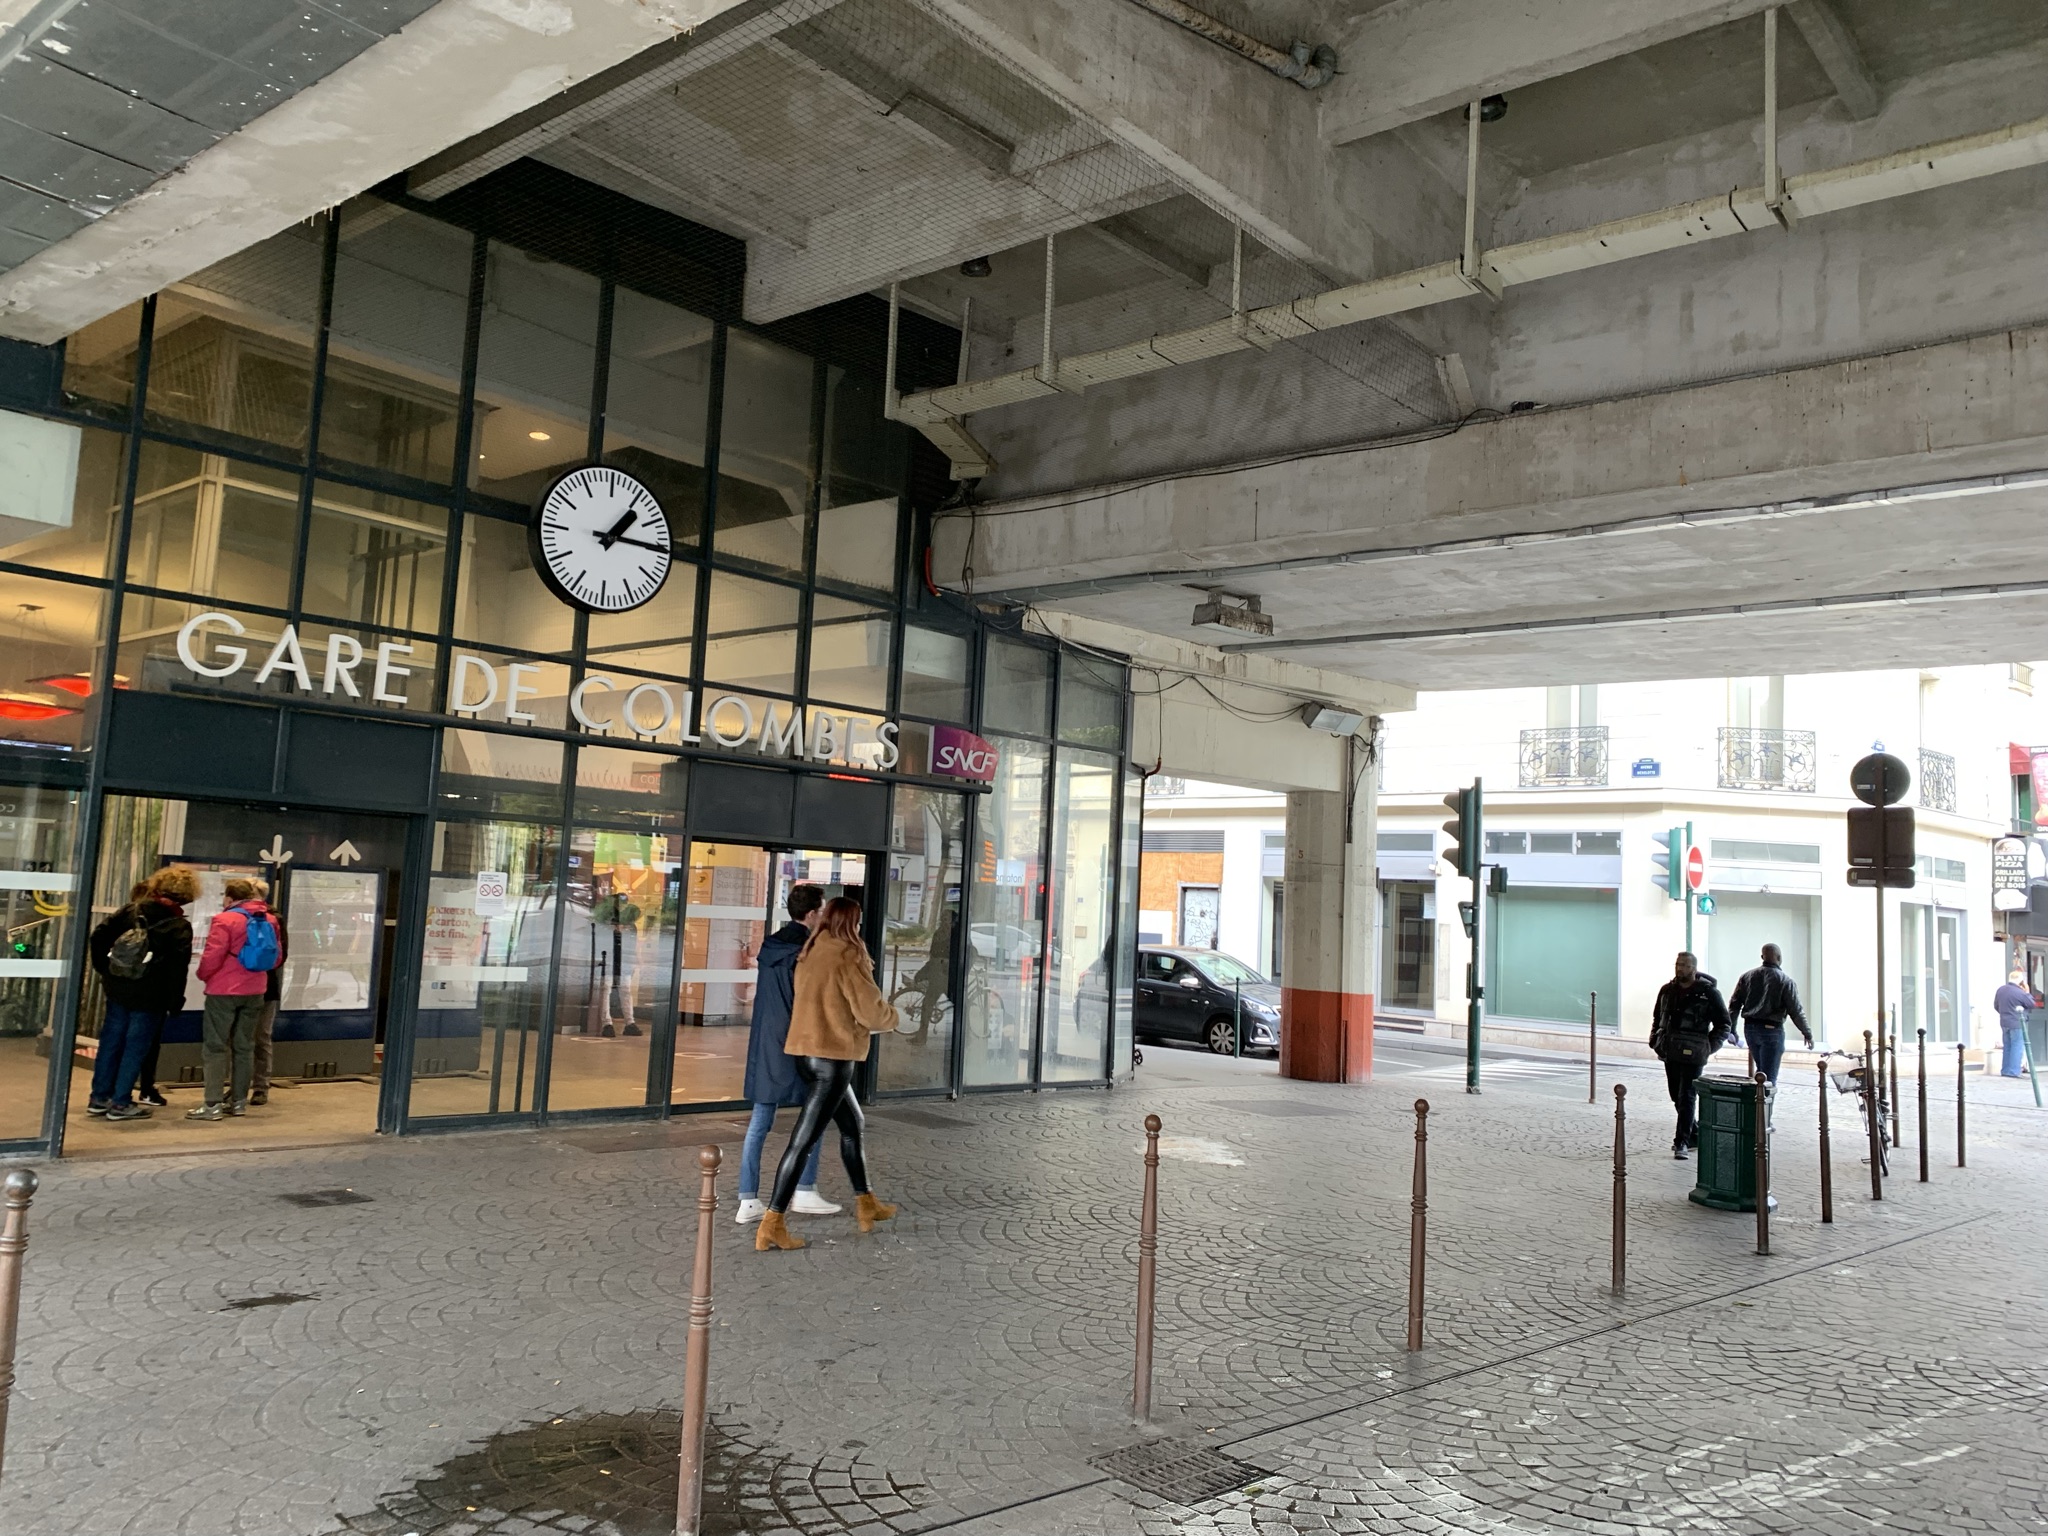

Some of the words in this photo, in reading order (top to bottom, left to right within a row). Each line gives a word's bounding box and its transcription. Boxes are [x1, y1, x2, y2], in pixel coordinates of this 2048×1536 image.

[177, 612, 413, 704] GARE
[452, 655, 541, 721] DE
[570, 674, 899, 769] COLOMBES
[936, 746, 996, 773] SNCF
[1298, 849, 1304, 859] 5
